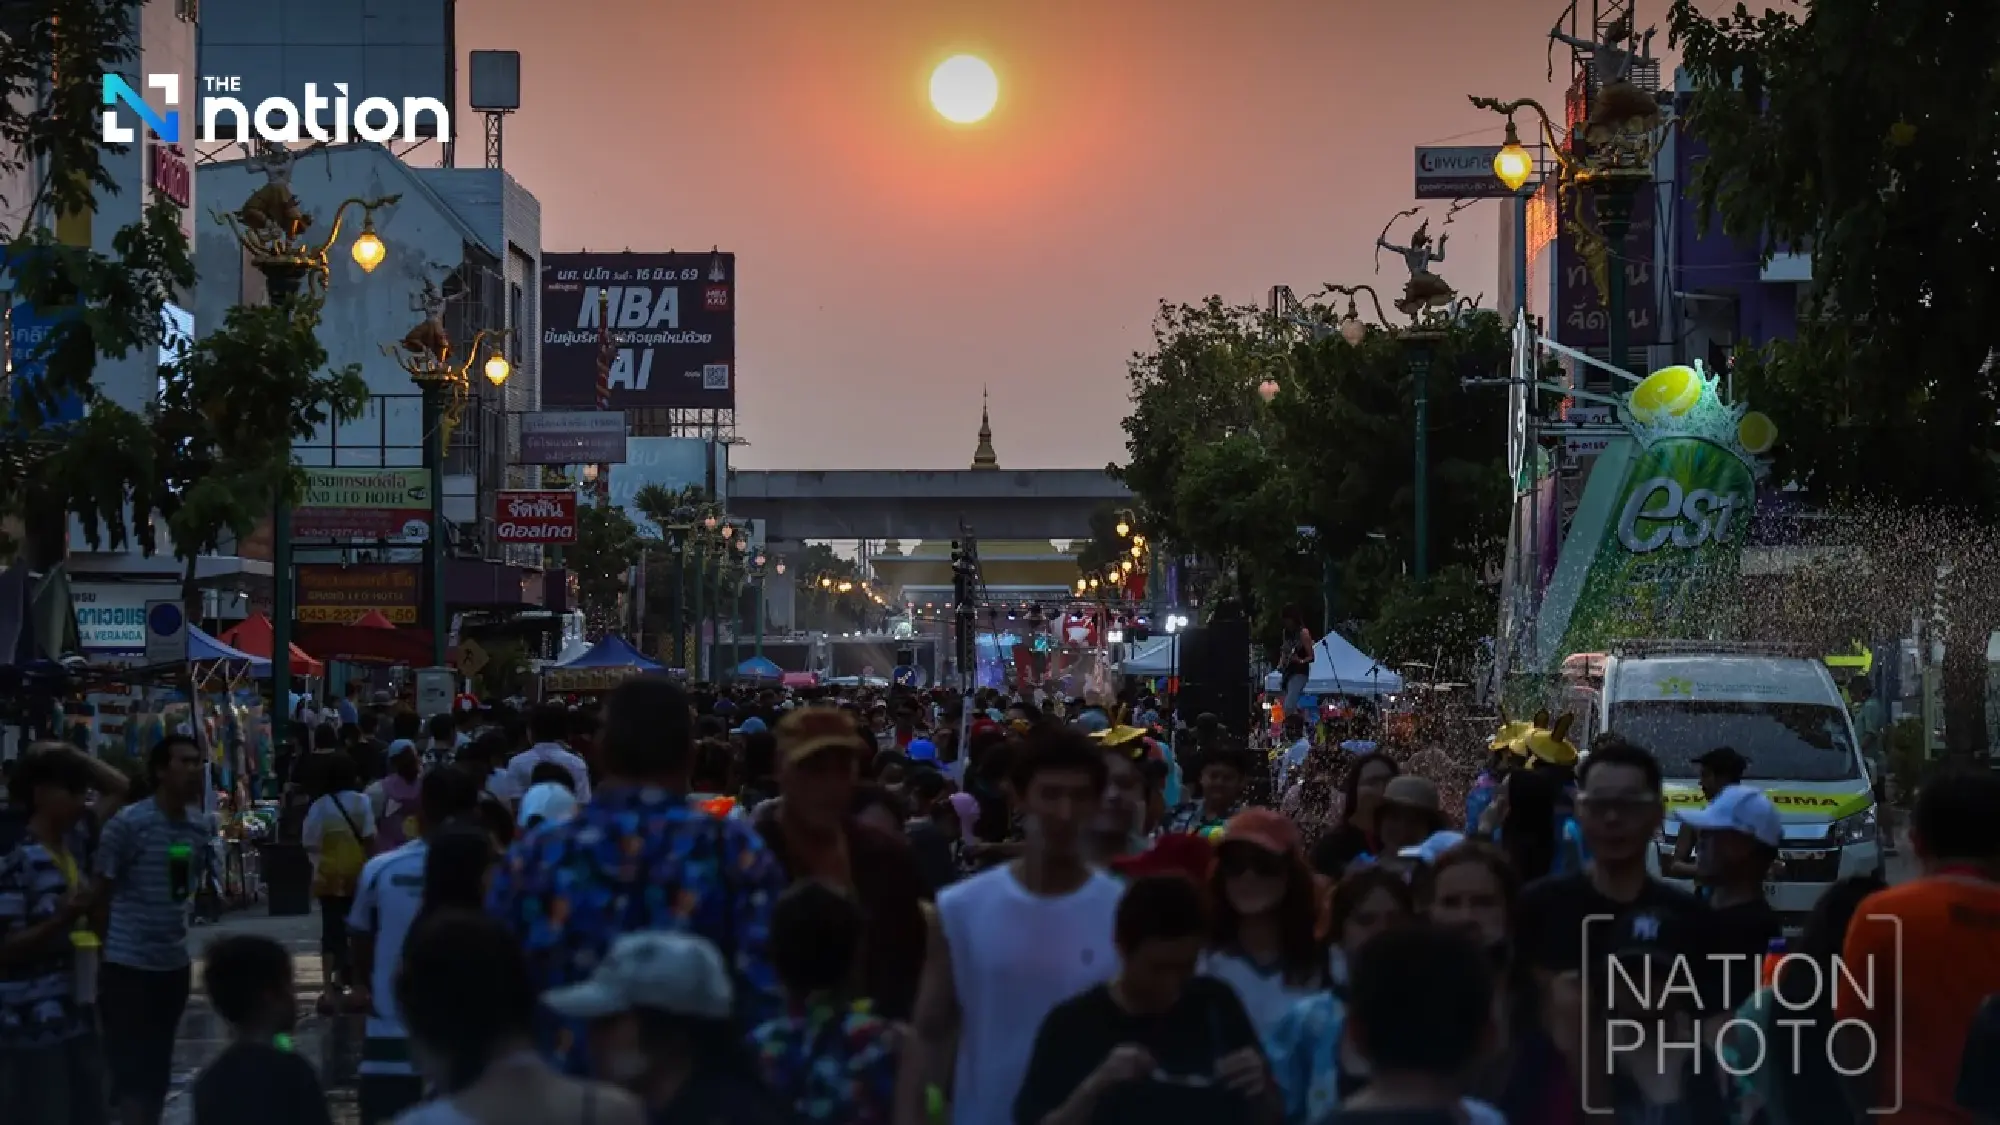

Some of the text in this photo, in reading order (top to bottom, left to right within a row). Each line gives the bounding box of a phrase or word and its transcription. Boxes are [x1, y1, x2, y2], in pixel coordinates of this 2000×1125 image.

[636, 268, 650, 281] 16
[681, 267, 699, 281] 69
[577, 285, 679, 329] MBA
[607, 348, 655, 390] AI
[365, 490, 405, 504] HOTEL
[508, 497, 564, 518] จัดฟัน
[1617, 476, 1745, 553] est
[95, 630, 143, 641] VERANDA
